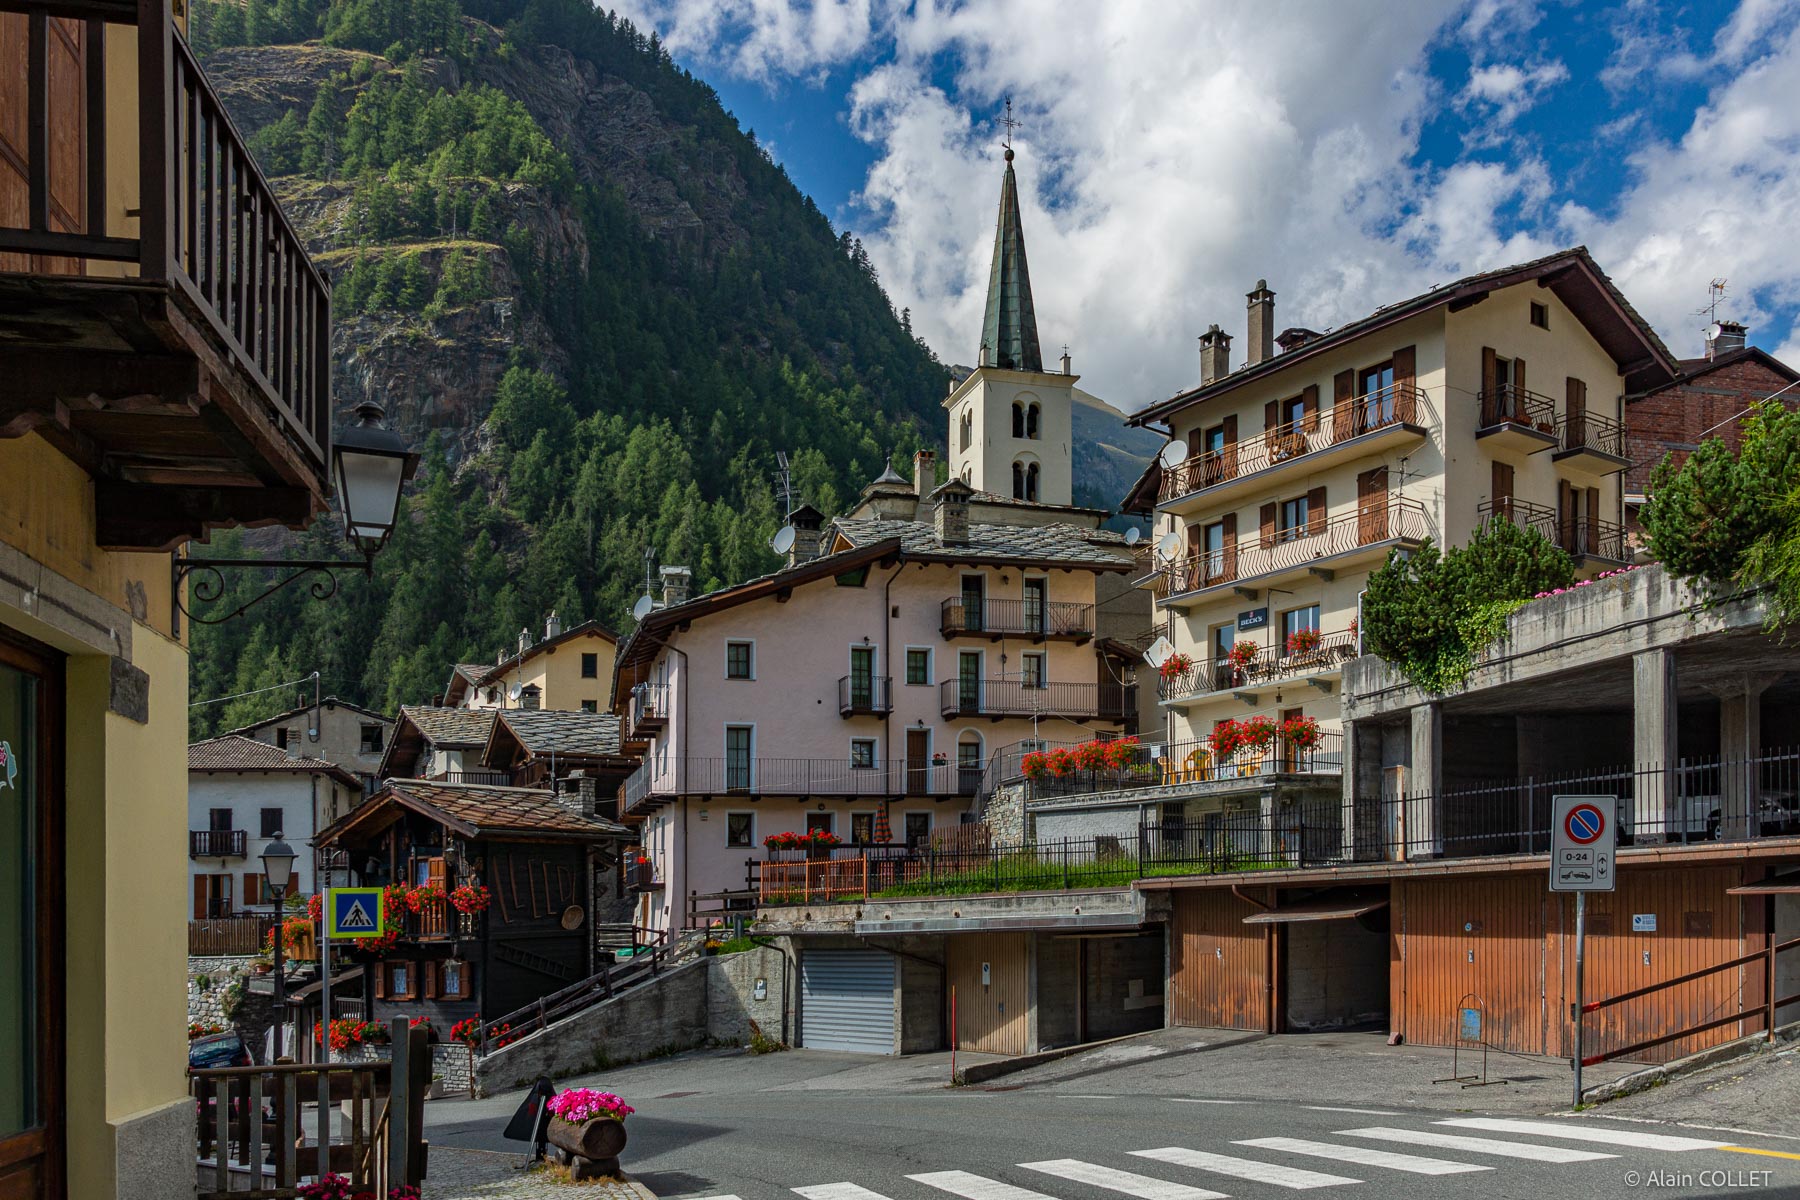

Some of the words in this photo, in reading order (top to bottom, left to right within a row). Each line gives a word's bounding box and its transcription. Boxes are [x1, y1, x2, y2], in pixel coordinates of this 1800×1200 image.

[1240, 615, 1263, 626] BECK'S
[1566, 853, 1588, 861] 0-24
[757, 979, 764, 990] P
